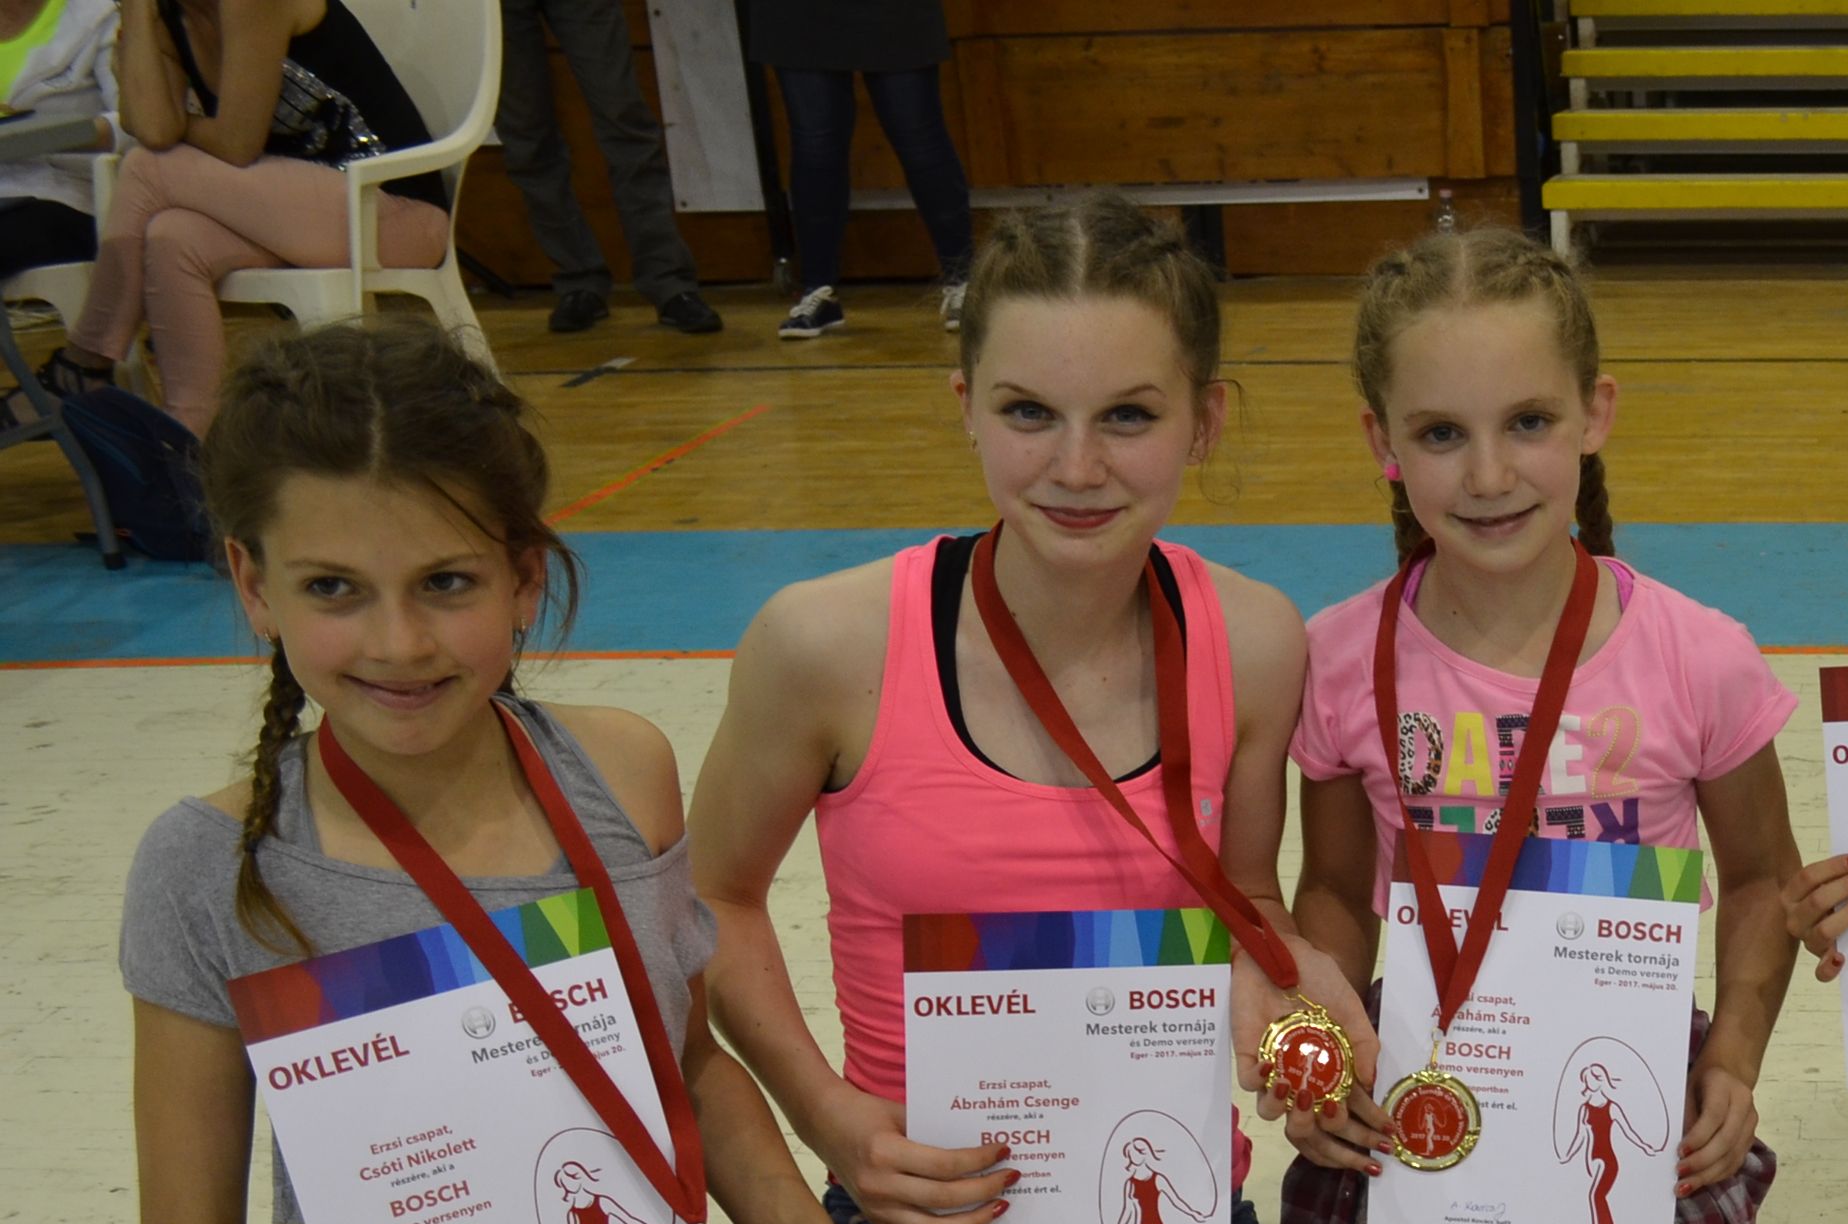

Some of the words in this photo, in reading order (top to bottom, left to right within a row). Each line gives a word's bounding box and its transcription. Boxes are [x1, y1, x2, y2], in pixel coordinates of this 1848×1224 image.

[1597, 919, 1681, 943] BOSCH
[1554, 946, 1622, 962] Mesterek
[1627, 953, 1679, 968] tornája
[1608, 966, 1637, 976] Demo
[1639, 971, 1678, 981] verseny
[1594, 978, 1611, 986] Eger
[1618, 979, 1639, 988] 2017.
[508, 978, 607, 1021] BSCH
[914, 989, 1035, 1016] OKLEVÉL
[1129, 988, 1214, 1009] BOSCH
[1477, 995, 1516, 1006] csapat,
[1500, 1011, 1529, 1024] Sára
[1086, 1021, 1157, 1035] Mesterek
[1162, 1019, 1215, 1034] tornája
[472, 1032, 543, 1063] Mestere
[1143, 1038, 1173, 1046] Demo
[1176, 1038, 1215, 1046] verseny
[1445, 1041, 1510, 1059] BOSCH
[268, 1033, 409, 1090] OKLEVÉL
[526, 1055, 539, 1064] és
[530, 1067, 550, 1077] Eger
[610, 1044, 625, 1054] 20.
[1155, 1050, 1176, 1058] 2017.
[1466, 1066, 1523, 1077] versenyen
[979, 1079, 1006, 1089] Erzsi
[1009, 1079, 1051, 1091] csapat,
[950, 1096, 1019, 1110] Ábrahám
[1024, 1096, 1079, 1109] Csenge
[1506, 1102, 1517, 1110] el.
[370, 1137, 402, 1154] Erzsi
[405, 1125, 453, 1144] csapat,
[981, 1129, 1049, 1145] BOSCH
[359, 1157, 403, 1180] Csóti
[406, 1138, 476, 1167] Nikolett
[1010, 1151, 1065, 1161] ersenyen
[390, 1172, 430, 1187] részére,
[432, 1165, 446, 1174] aki
[1050, 1184, 1061, 1193] el.
[390, 1180, 469, 1217] BOSCH
